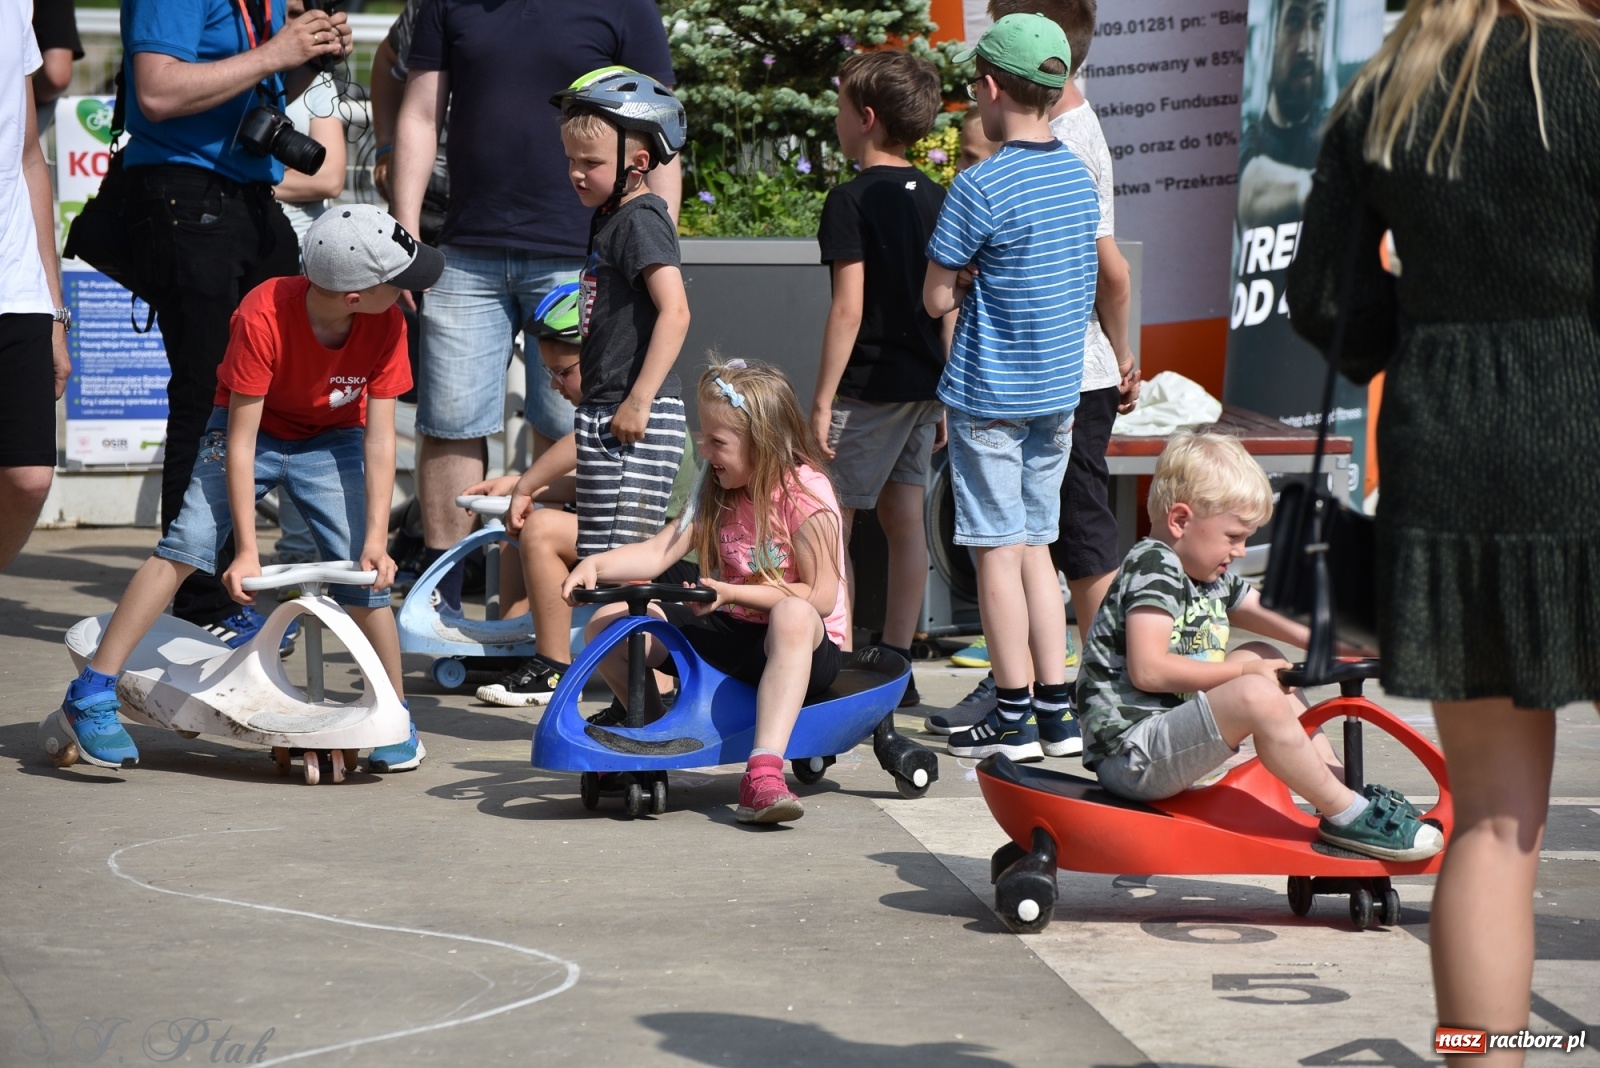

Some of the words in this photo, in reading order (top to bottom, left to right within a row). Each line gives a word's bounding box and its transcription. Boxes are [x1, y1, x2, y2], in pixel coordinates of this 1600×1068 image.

[1094, 16, 1175, 37] /09.01281
[1193, 56, 1208, 67] w
[1211, 51, 1244, 66] 85%
[1160, 94, 1239, 112] Funduszu
[1139, 141, 1175, 154] oraz
[1179, 135, 1200, 149] do
[1205, 131, 1237, 147] 10%
[1238, 220, 1304, 277] TRE
[330, 376, 367, 385] POLSKA
[1212, 973, 1351, 1005] 5
